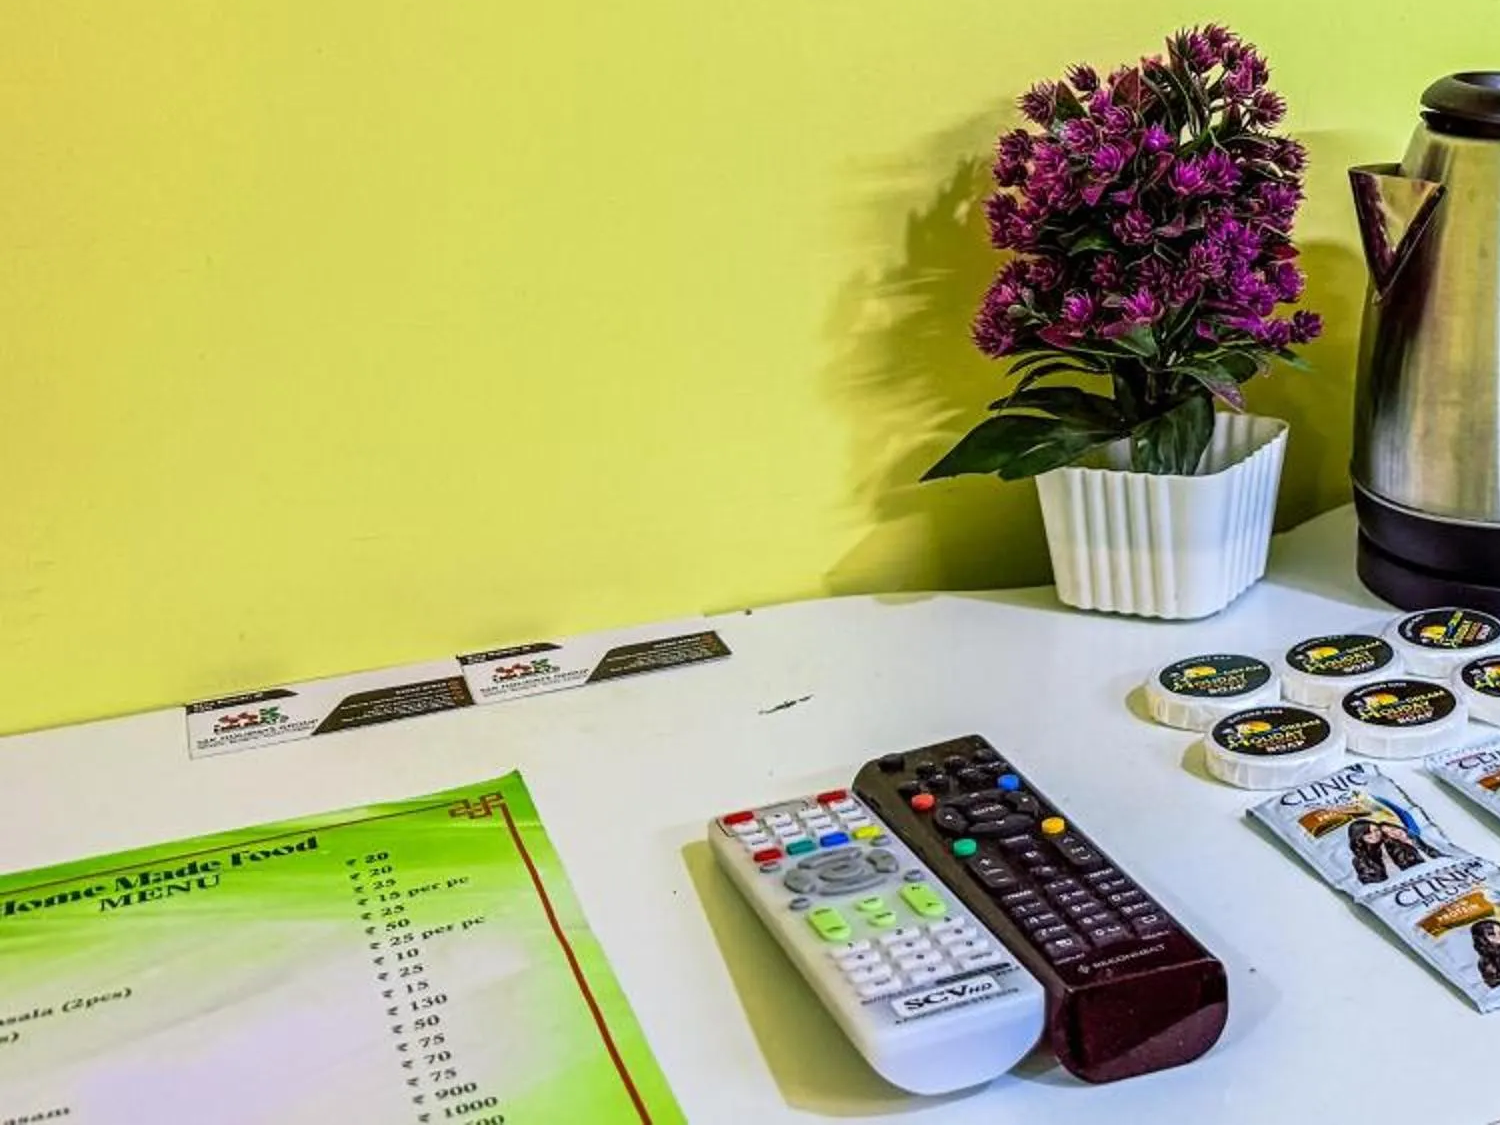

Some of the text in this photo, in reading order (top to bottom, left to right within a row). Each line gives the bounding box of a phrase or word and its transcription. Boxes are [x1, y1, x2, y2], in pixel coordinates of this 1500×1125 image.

[1280, 771, 1369, 807] CLINIC
[115, 859, 221, 892] Made
[230, 836, 318, 867] Food
[365, 851, 389, 864] 20
[369, 865, 393, 877] 20
[100, 875, 220, 912] MENU
[385, 918, 410, 932] 50
[389, 933, 414, 947] 25
[396, 947, 419, 961] 10
[399, 963, 424, 977] 25
[406, 980, 429, 994] 15
[410, 994, 448, 1011] 130
[904, 984, 968, 1011] SCV
[414, 1014, 440, 1030] 50
[418, 1033, 445, 1048] 75
[424, 1050, 452, 1064] 70
[429, 1067, 457, 1082] 75
[435, 1082, 478, 1100] 900
[444, 1096, 499, 1119] 1000
